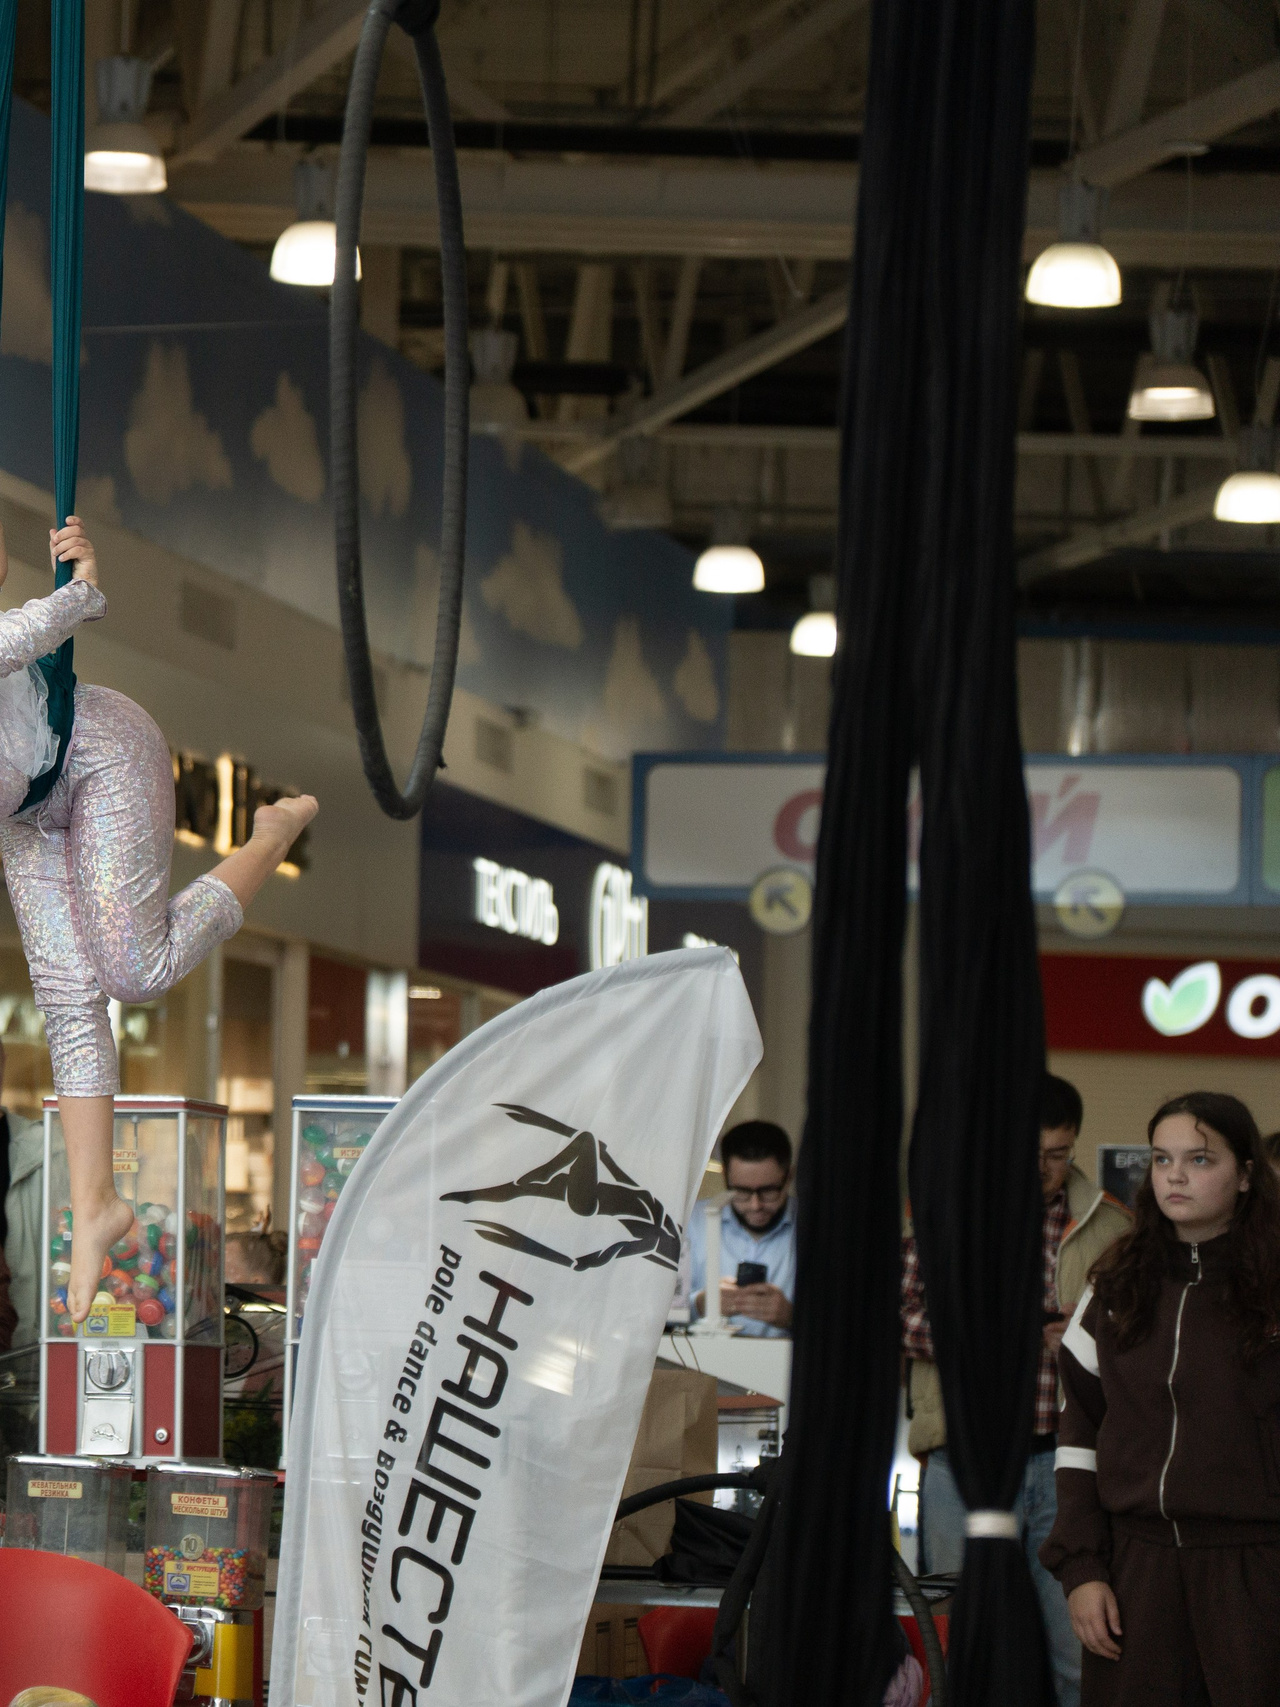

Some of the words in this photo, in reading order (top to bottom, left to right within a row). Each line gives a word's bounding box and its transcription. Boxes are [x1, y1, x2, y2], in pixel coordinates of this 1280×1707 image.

[425, 1244, 462, 1315] pole
[392, 1321, 438, 1414] dance
[384, 1419, 408, 1443] &
[31, 1481, 77, 1490] ЖЕВАТЕЛЬНАЯ
[41, 1489, 69, 1497] РЕЗИНКА
[178, 1495, 220, 1506] КОНФЕТЫ
[173, 1505, 209, 1515] НЕСКОЛЬКО
[210, 1508, 227, 1517] ШТУК
[183, 1537, 198, 1552] 10
[354, 1634, 372, 1707] гим
